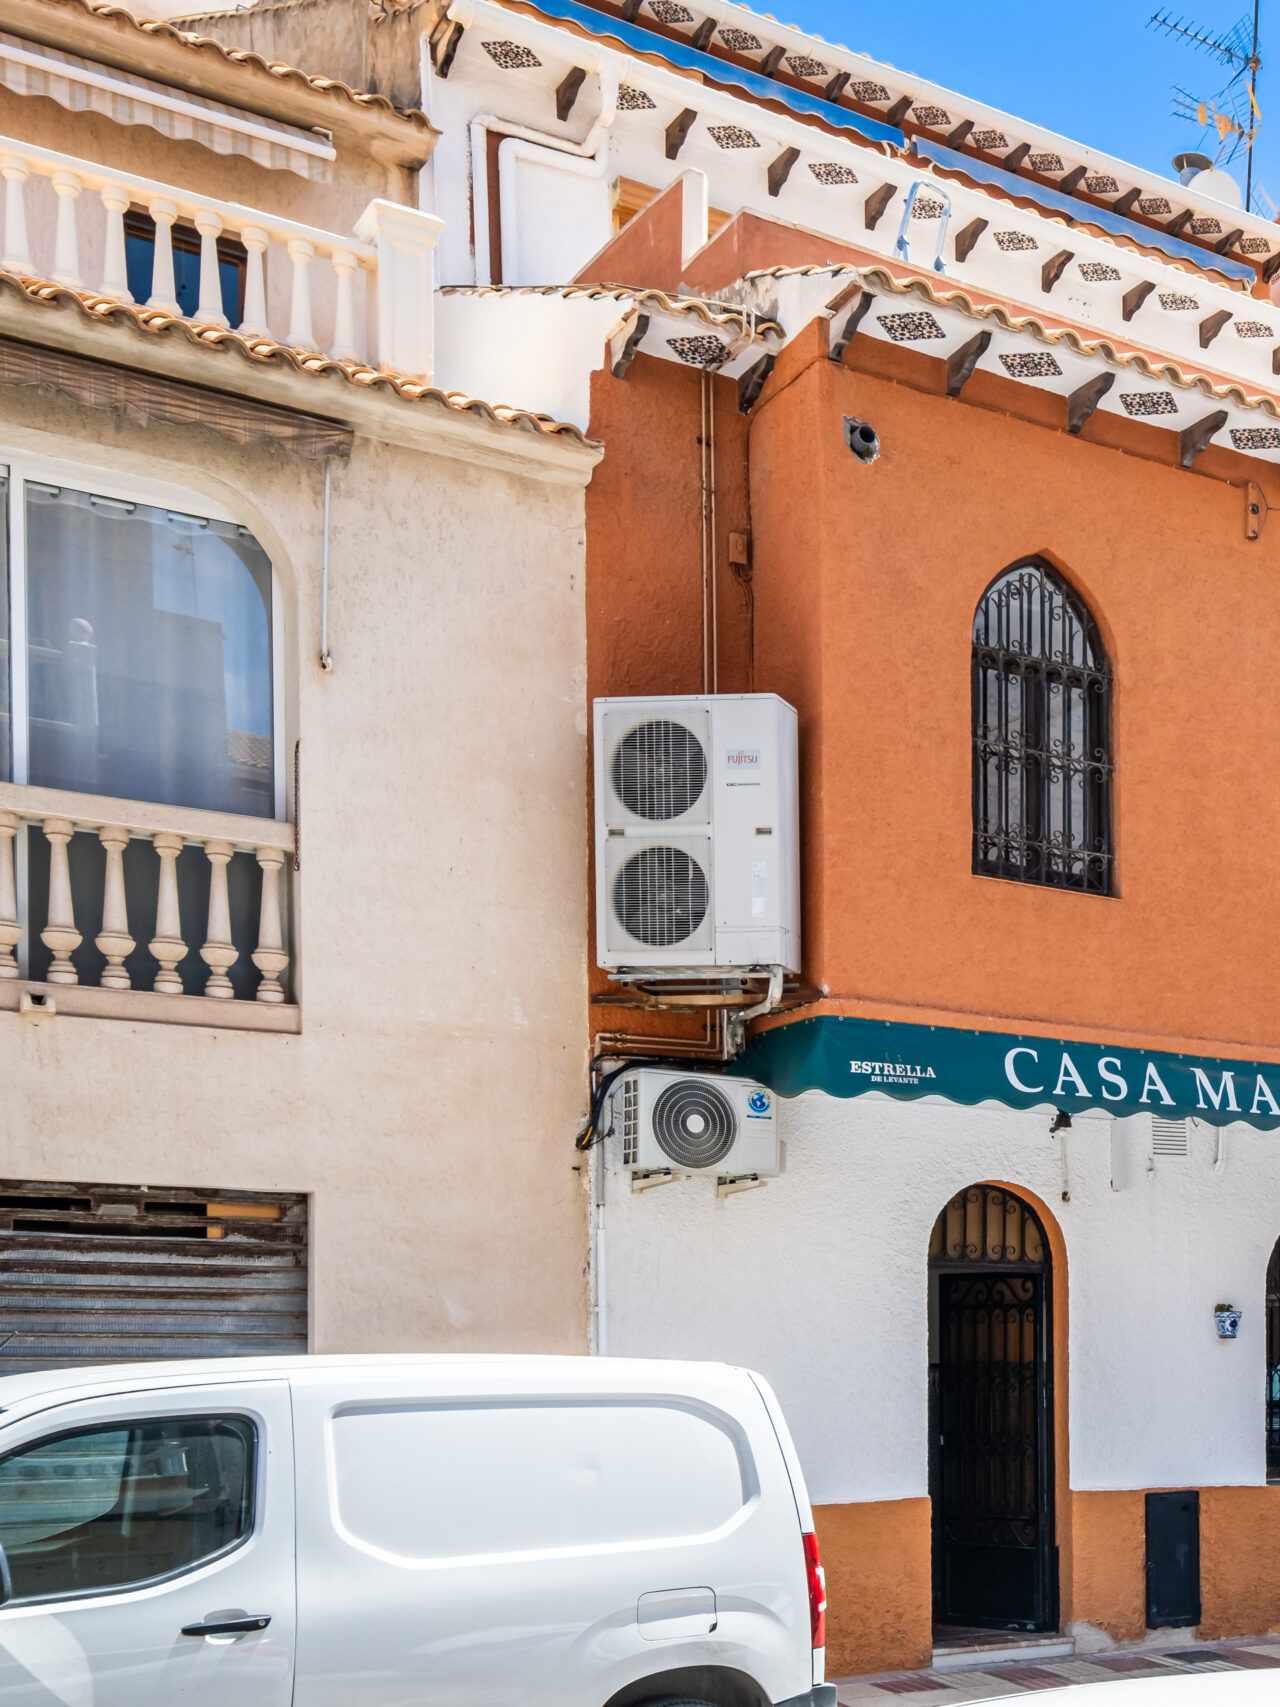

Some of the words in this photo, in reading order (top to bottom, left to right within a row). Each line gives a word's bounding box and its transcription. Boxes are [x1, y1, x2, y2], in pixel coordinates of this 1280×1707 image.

[727, 754, 758, 765] FUJITSU
[849, 1060, 936, 1078] ESTRELLA
[884, 1076, 919, 1084] LEVANTE
[1004, 1047, 1176, 1106] CASA
